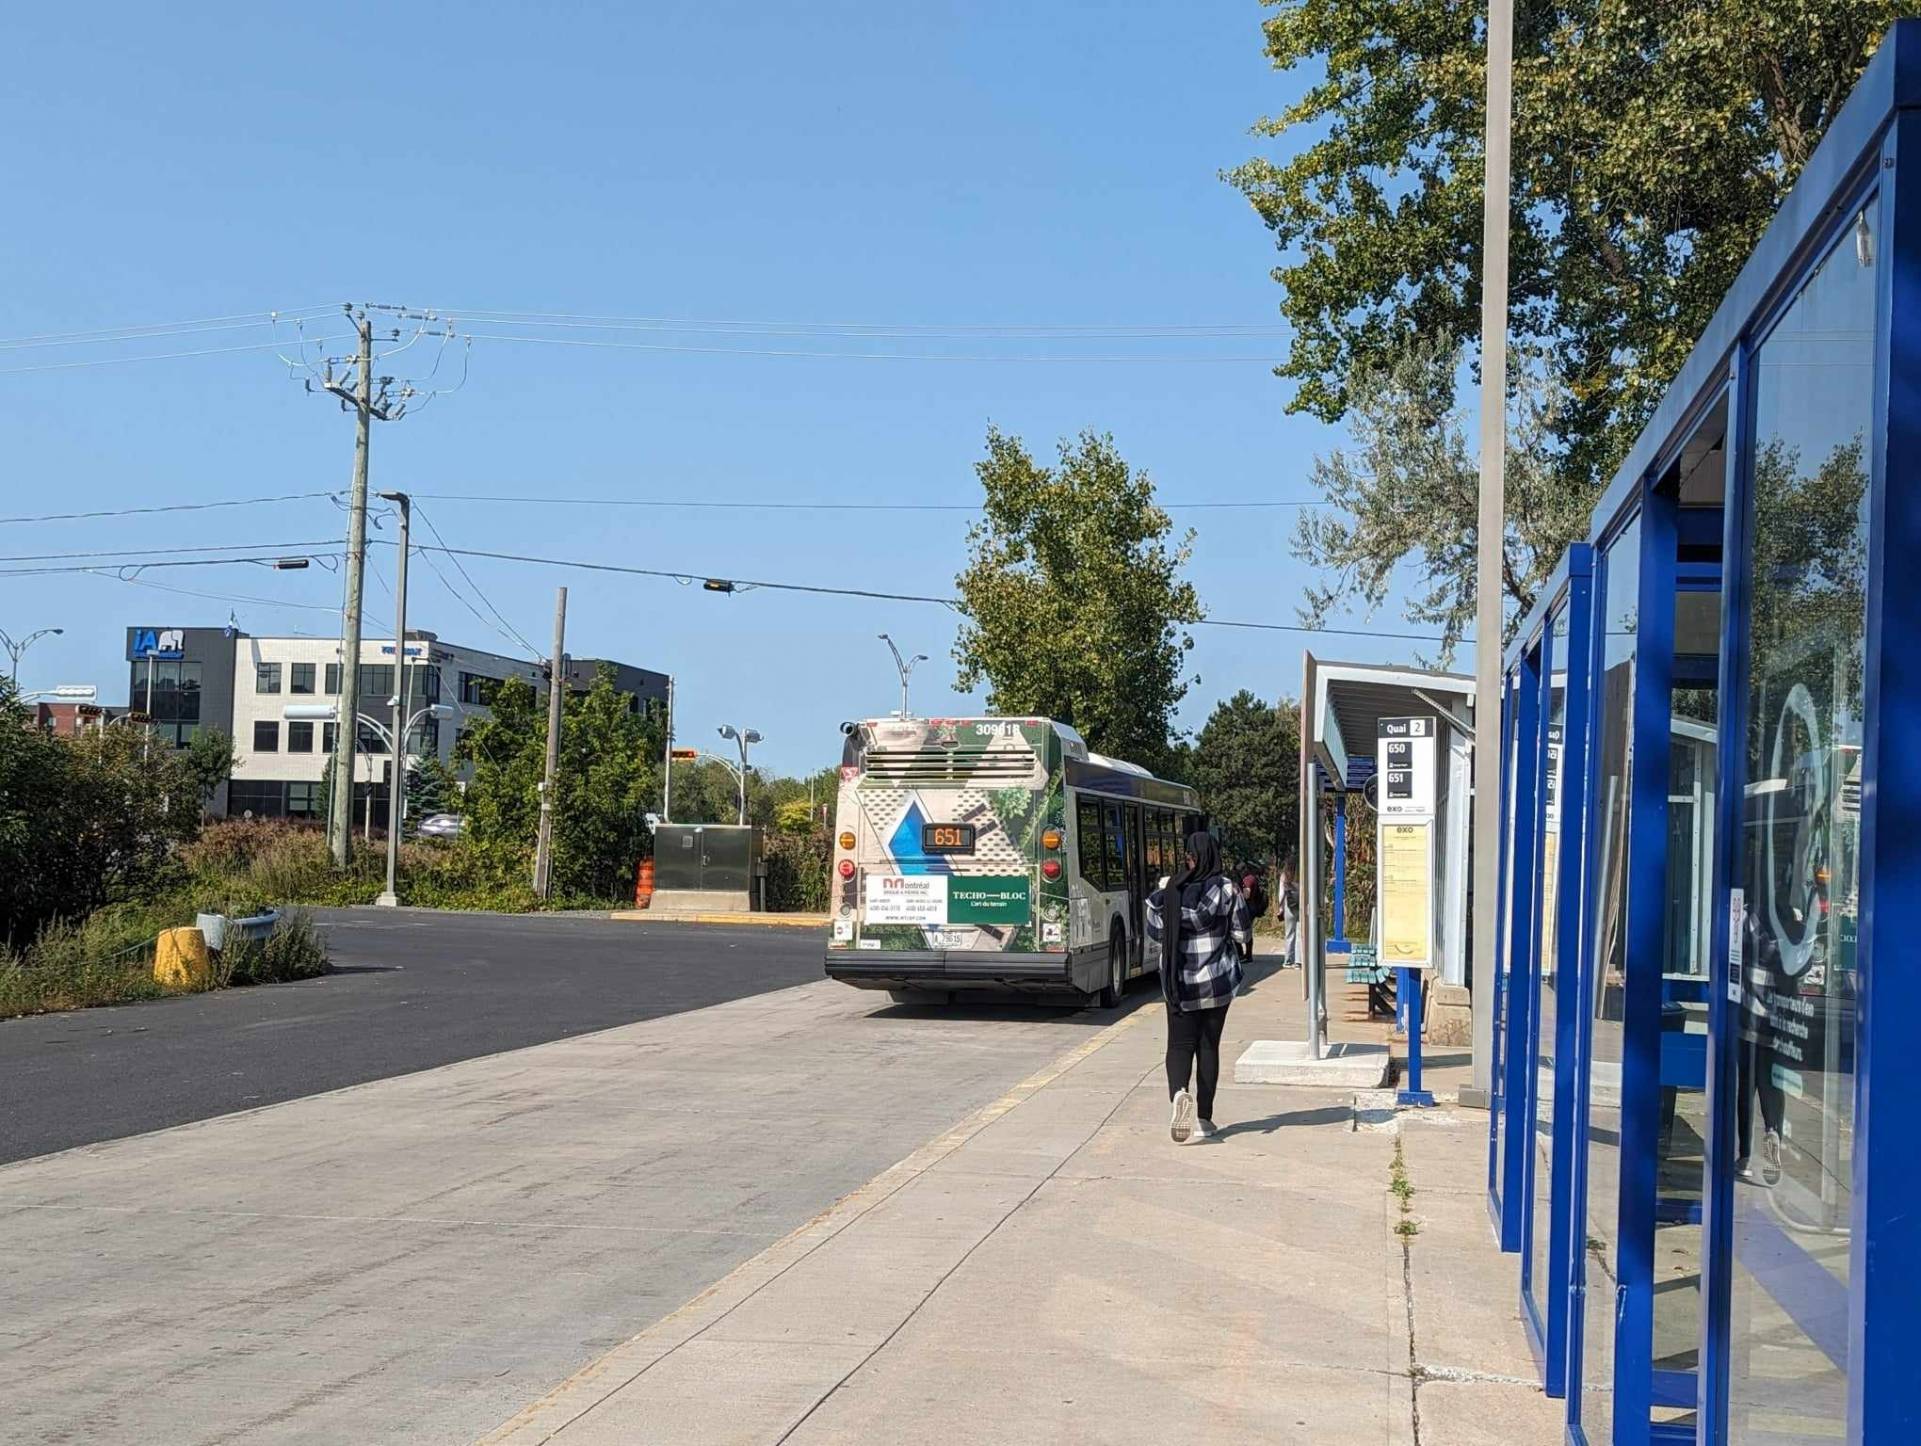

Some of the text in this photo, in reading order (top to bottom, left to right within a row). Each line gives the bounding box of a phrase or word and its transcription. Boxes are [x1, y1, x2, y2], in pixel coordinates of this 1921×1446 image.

[1386, 722, 1421, 734] Quai 2
[1388, 743, 1406, 754] 650
[1388, 773, 1404, 783] 651
[934, 828, 962, 846] 651
